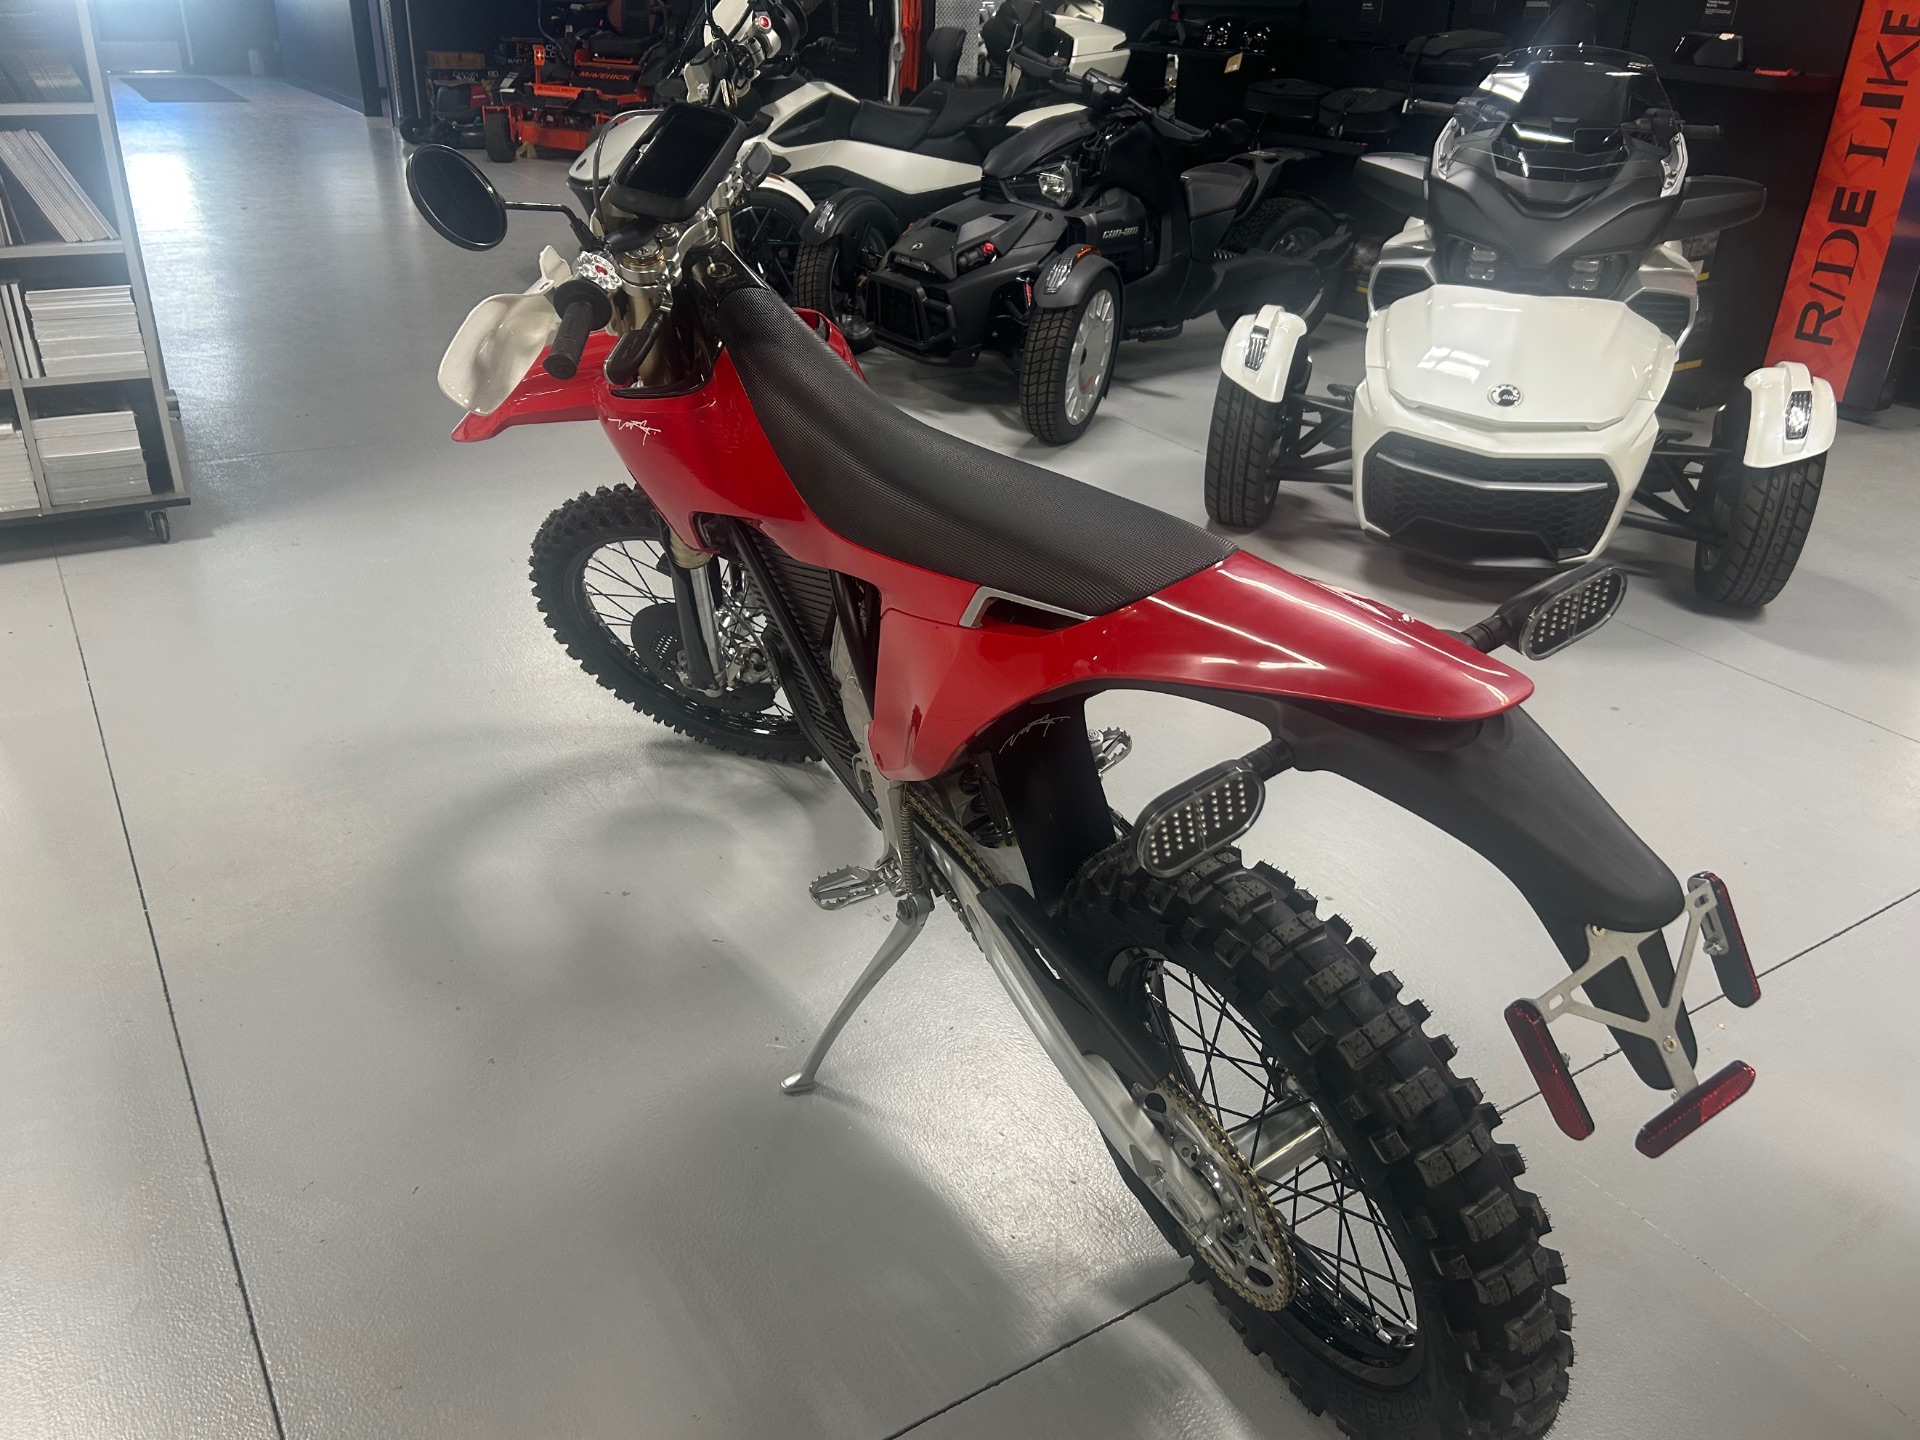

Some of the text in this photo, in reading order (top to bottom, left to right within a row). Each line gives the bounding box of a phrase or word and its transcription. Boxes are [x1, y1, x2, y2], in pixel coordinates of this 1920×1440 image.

[579, 71, 631, 80] MAVERICK
[1794, 9, 1920, 346] RIDE LIKE
